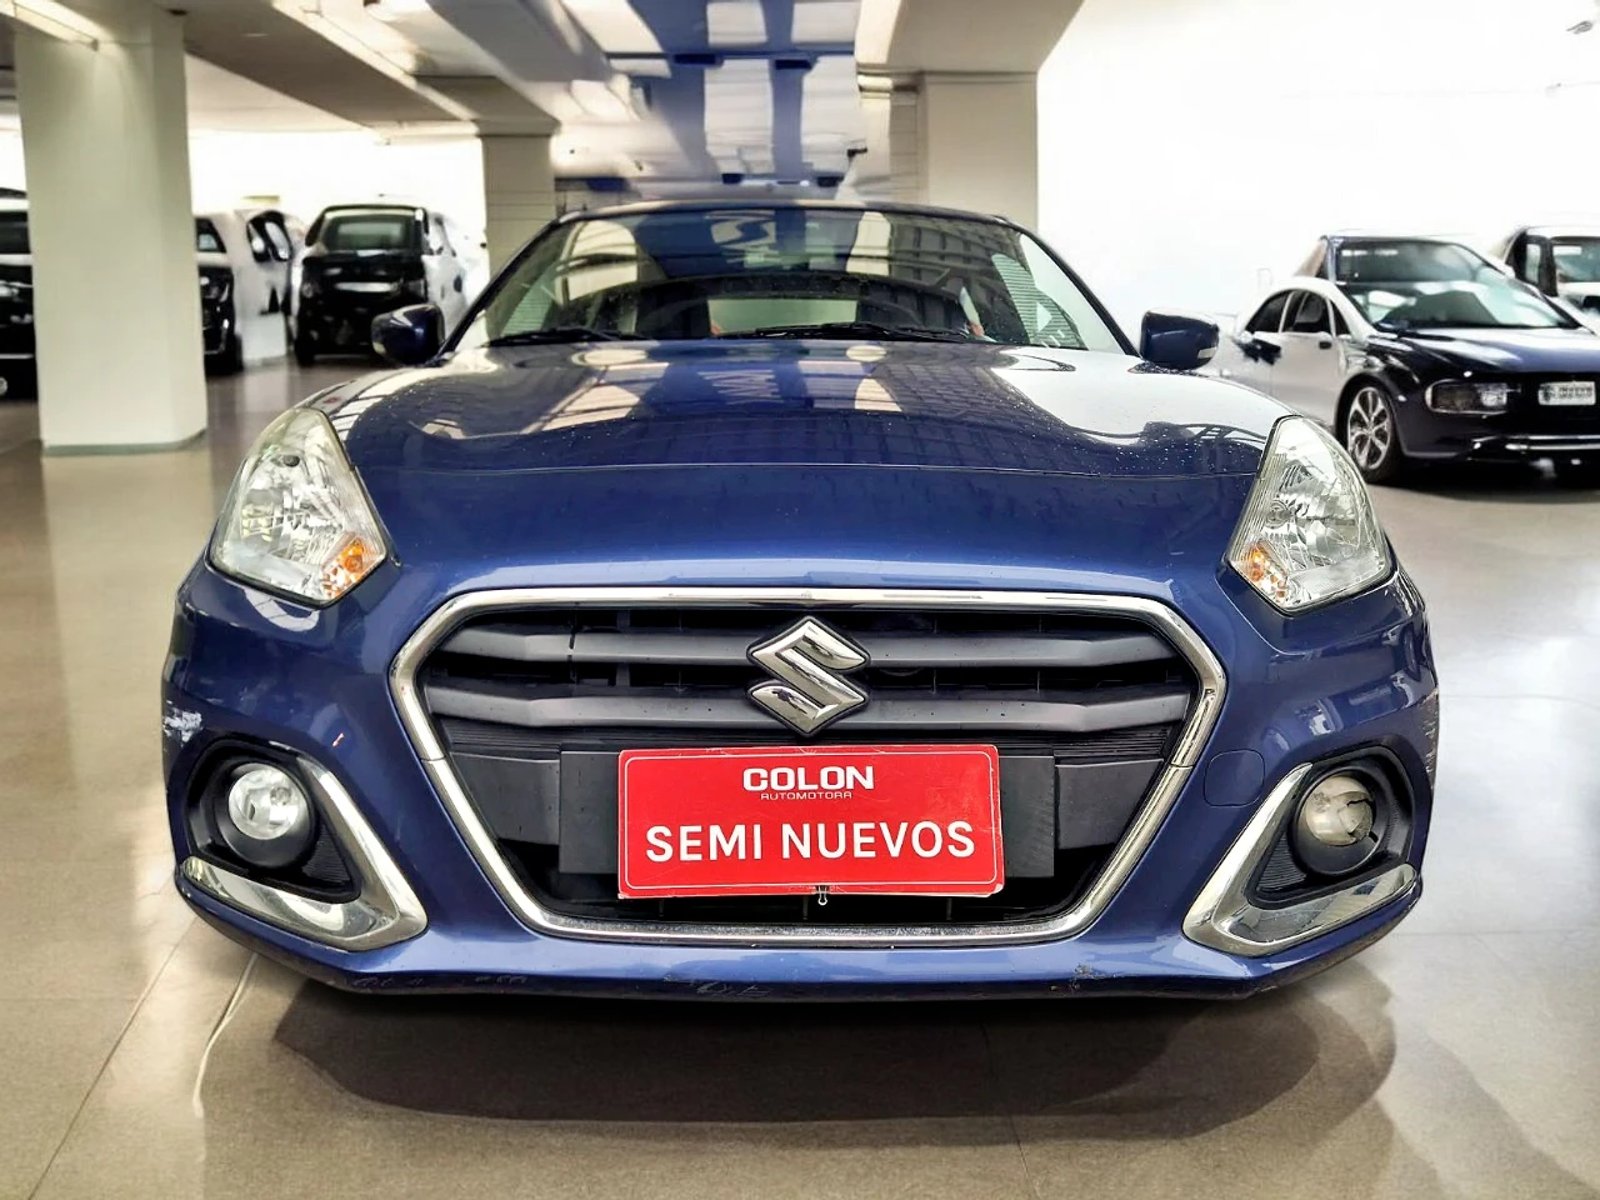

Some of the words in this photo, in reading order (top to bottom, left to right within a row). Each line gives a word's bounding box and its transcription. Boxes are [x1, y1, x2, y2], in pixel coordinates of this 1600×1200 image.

[743, 766, 874, 791] COLON
[760, 791, 852, 800] AUTOMOTORA
[646, 824, 762, 862] SEMI
[782, 820, 975, 859] NUEVOS
